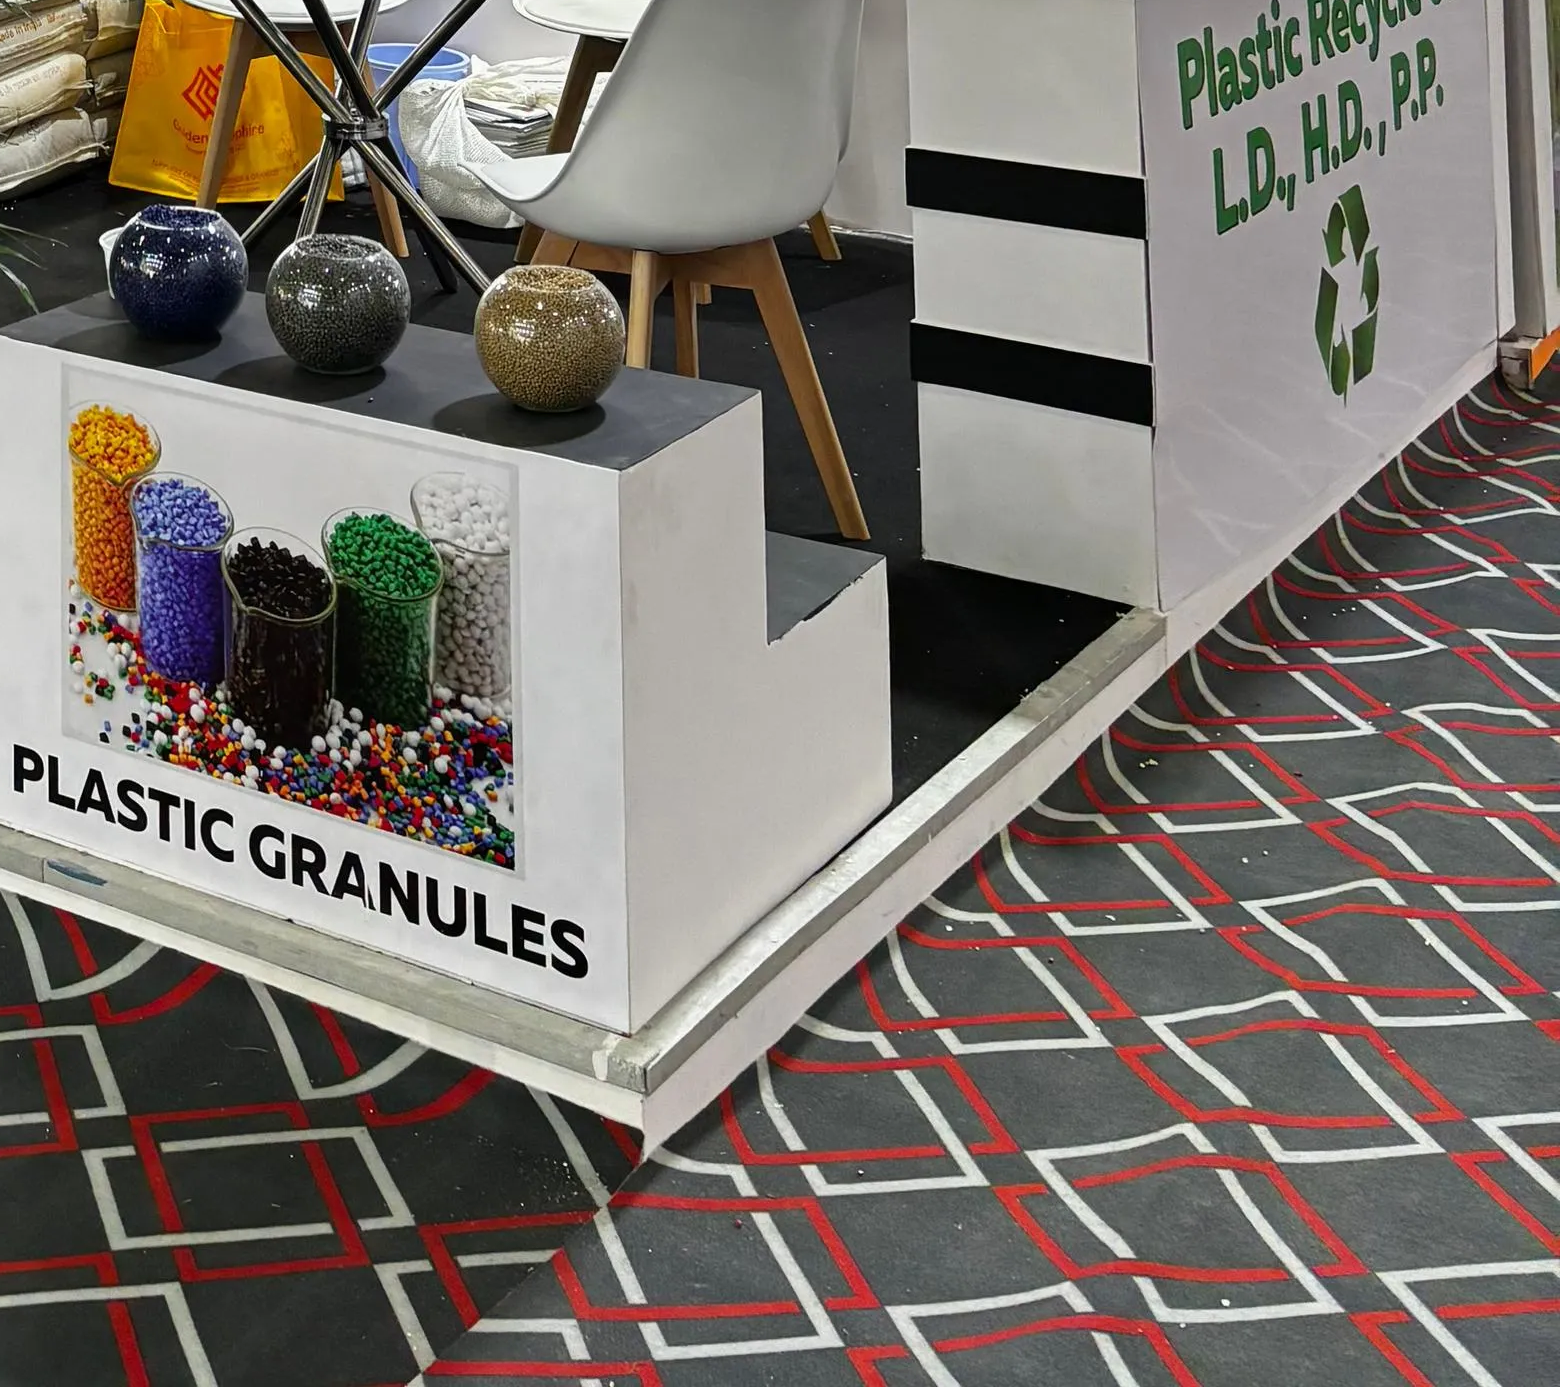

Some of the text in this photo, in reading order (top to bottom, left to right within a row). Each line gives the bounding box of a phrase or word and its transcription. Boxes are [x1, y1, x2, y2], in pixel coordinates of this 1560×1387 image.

[1212, 125, 1296, 235] L.D.,
[1389, 37, 1445, 133] P.P.
[11, 744, 589, 979] PLASTIC GRANULES
